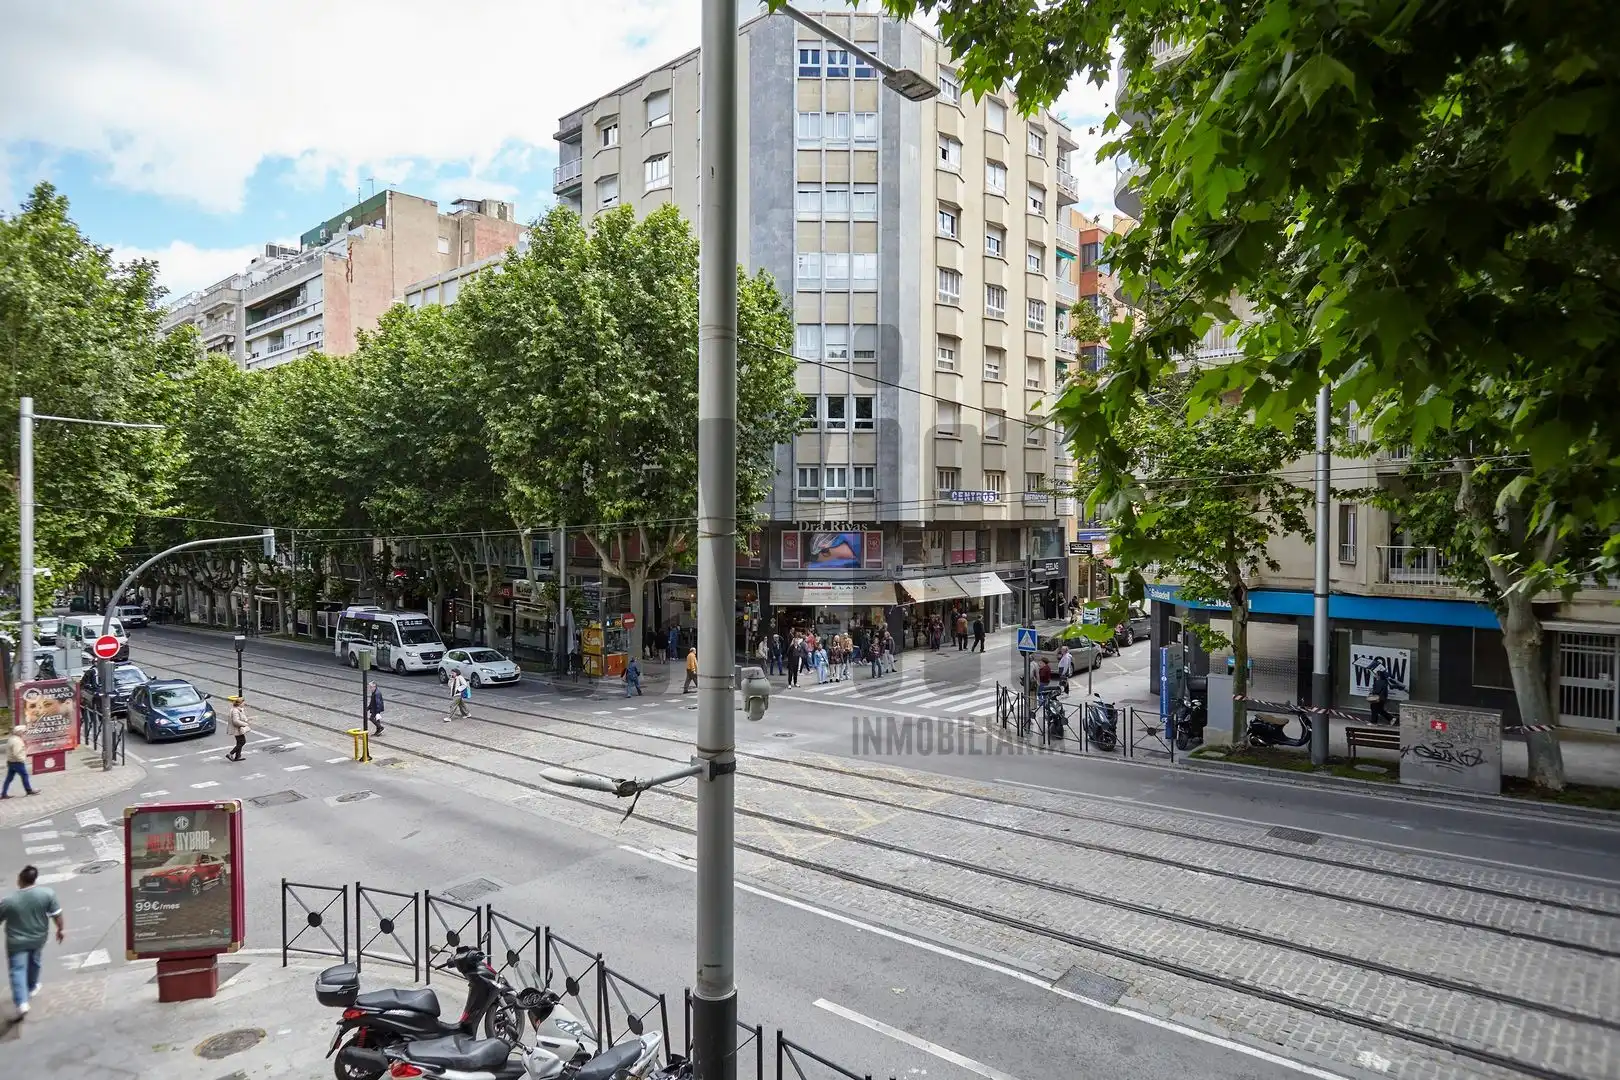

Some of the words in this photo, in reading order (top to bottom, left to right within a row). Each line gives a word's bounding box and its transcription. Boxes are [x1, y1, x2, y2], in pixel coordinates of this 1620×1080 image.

[952, 491, 994, 502] CENTROS
[799, 520, 828, 532] Dra.
[830, 521, 868, 532] Rivas
[175, 830, 217, 851] HYBRID+
[135, 901, 181, 913] 99€/mes
